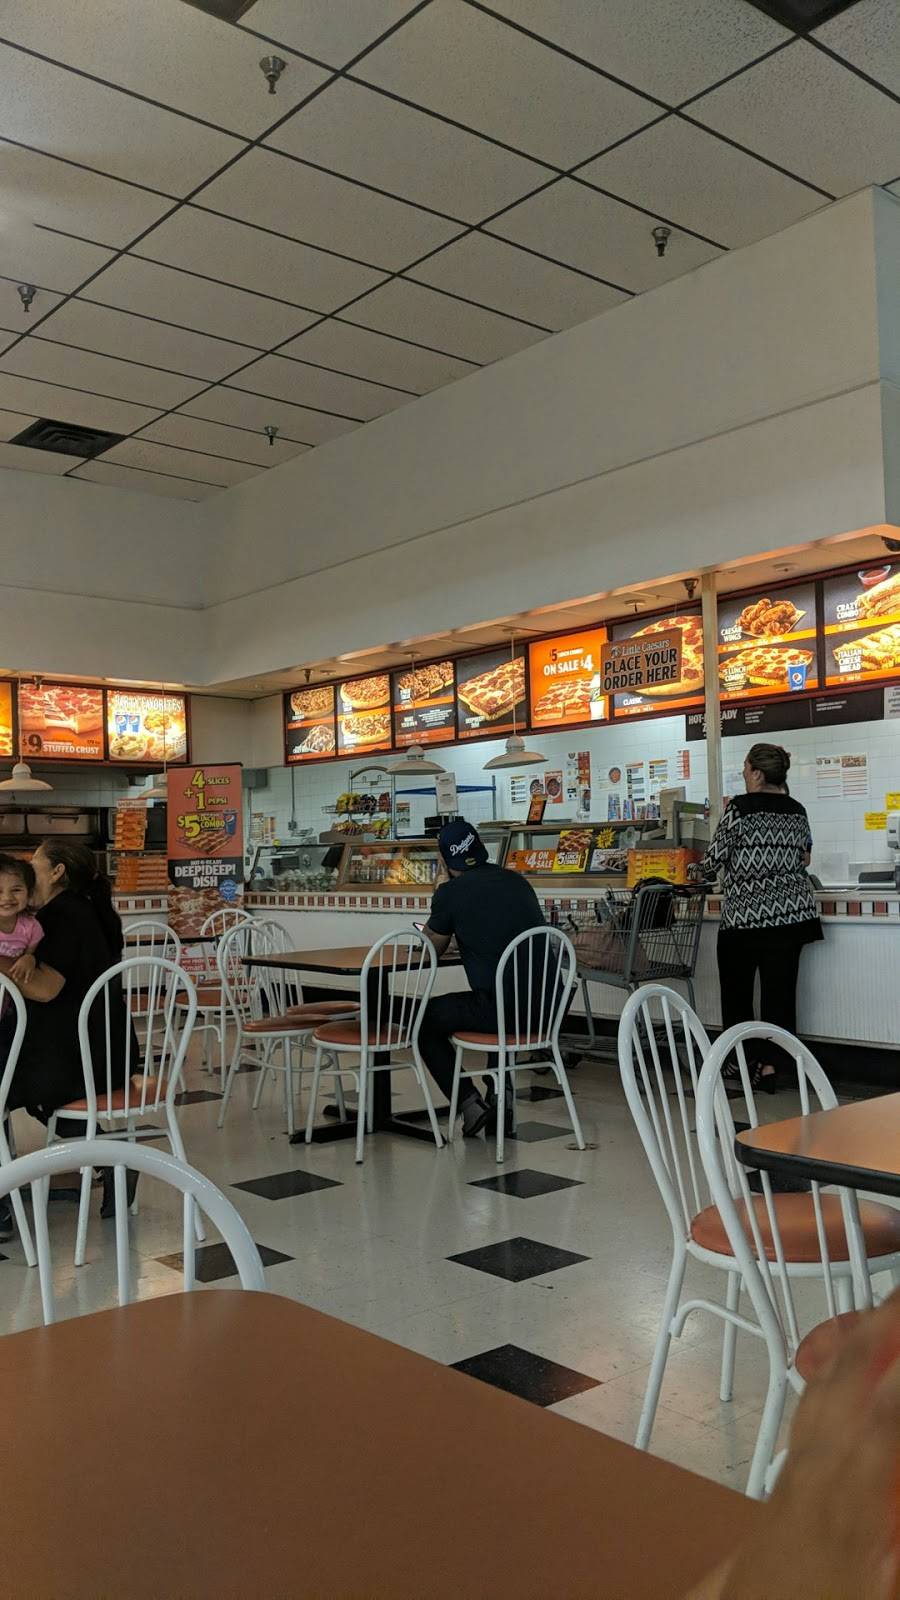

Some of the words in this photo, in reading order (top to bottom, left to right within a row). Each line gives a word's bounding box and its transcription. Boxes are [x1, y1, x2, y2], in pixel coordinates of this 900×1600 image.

[622, 644, 641, 656] Little
[642, 639, 671, 652] Caesars
[543, 663, 557, 676] ON
[558, 659, 580, 673] SALE
[604, 655, 641, 676] PLACE
[645, 648, 677, 667] YOUR
[604, 671, 643, 691] ORDER
[646, 664, 678, 684] HERE
[43, 744, 75, 753] STUFFED
[76, 745, 100, 754] CRUST
[192, 769, 206, 789] 4
[196, 791, 206, 810] 1
[177, 814, 201, 838] $5
[450, 832, 475, 856] Dodgers
[536, 860, 553, 869] SALE
[538, 851, 549, 860] ON
[192, 876, 218, 888] DISH
